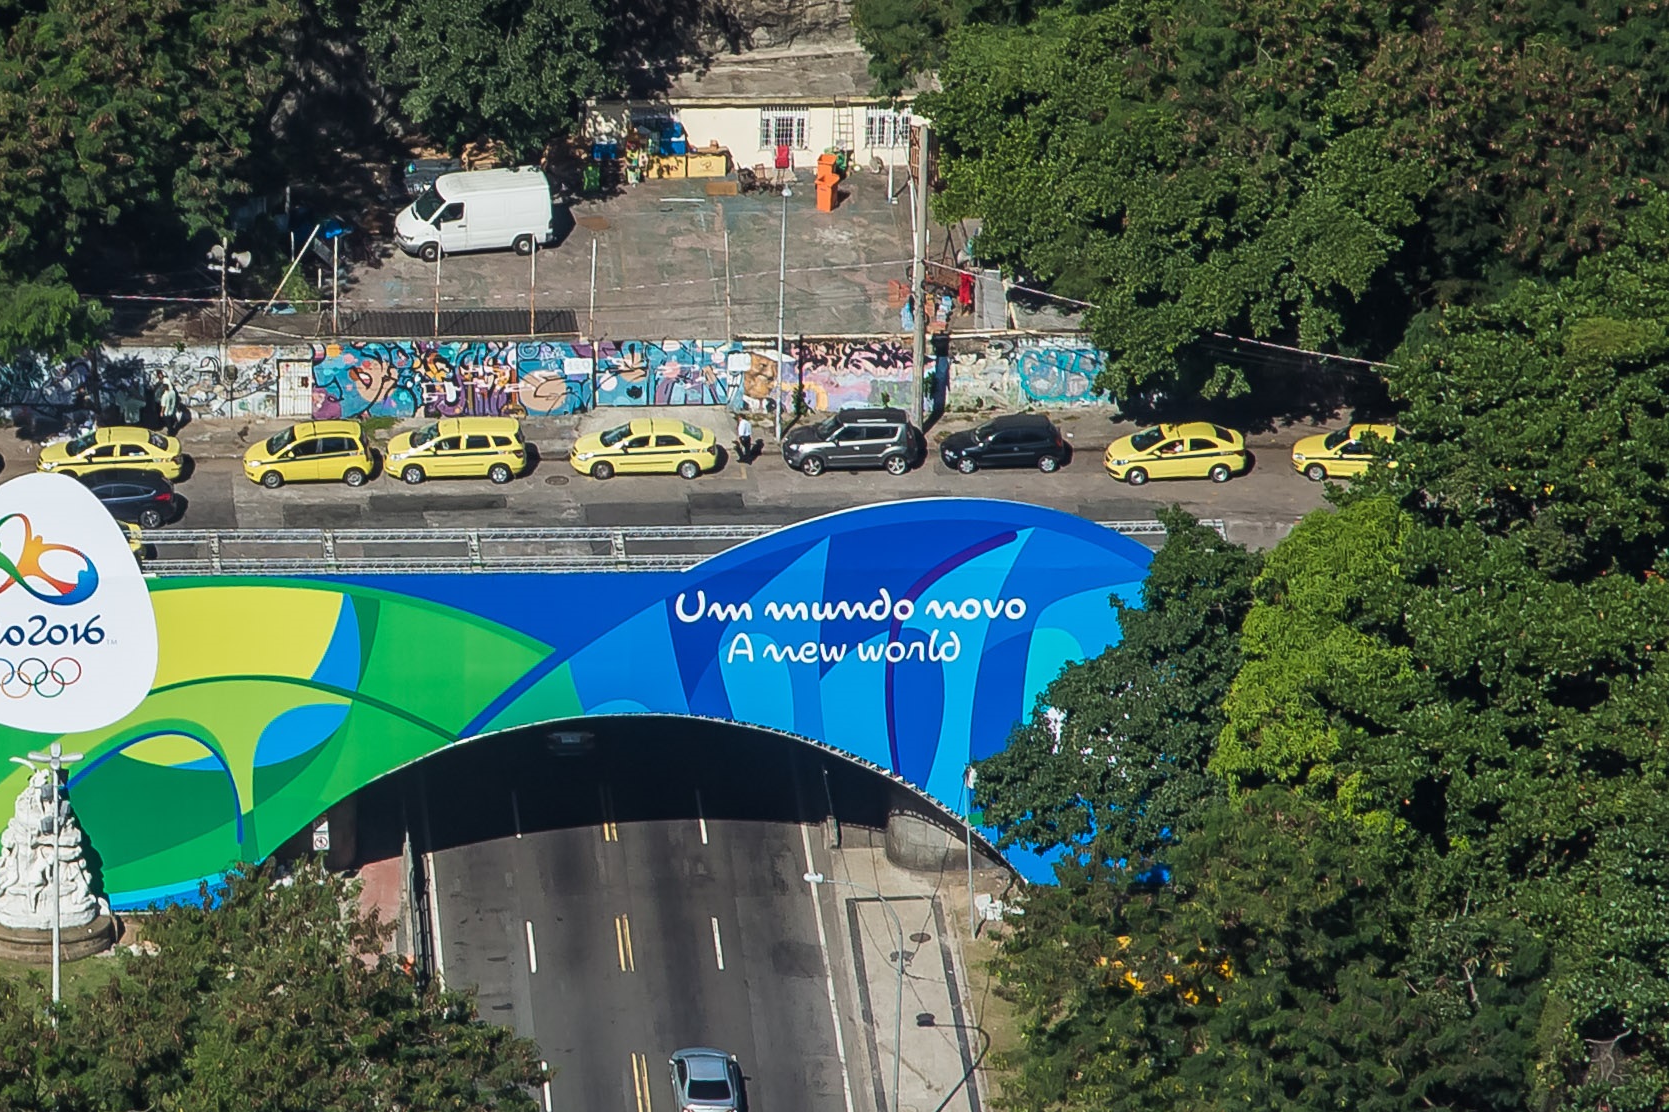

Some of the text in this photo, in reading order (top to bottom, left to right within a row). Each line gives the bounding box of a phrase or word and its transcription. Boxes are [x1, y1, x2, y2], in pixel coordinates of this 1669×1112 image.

[676, 589, 1025, 622] Um mundo novo
[729, 630, 960, 662] A new world
